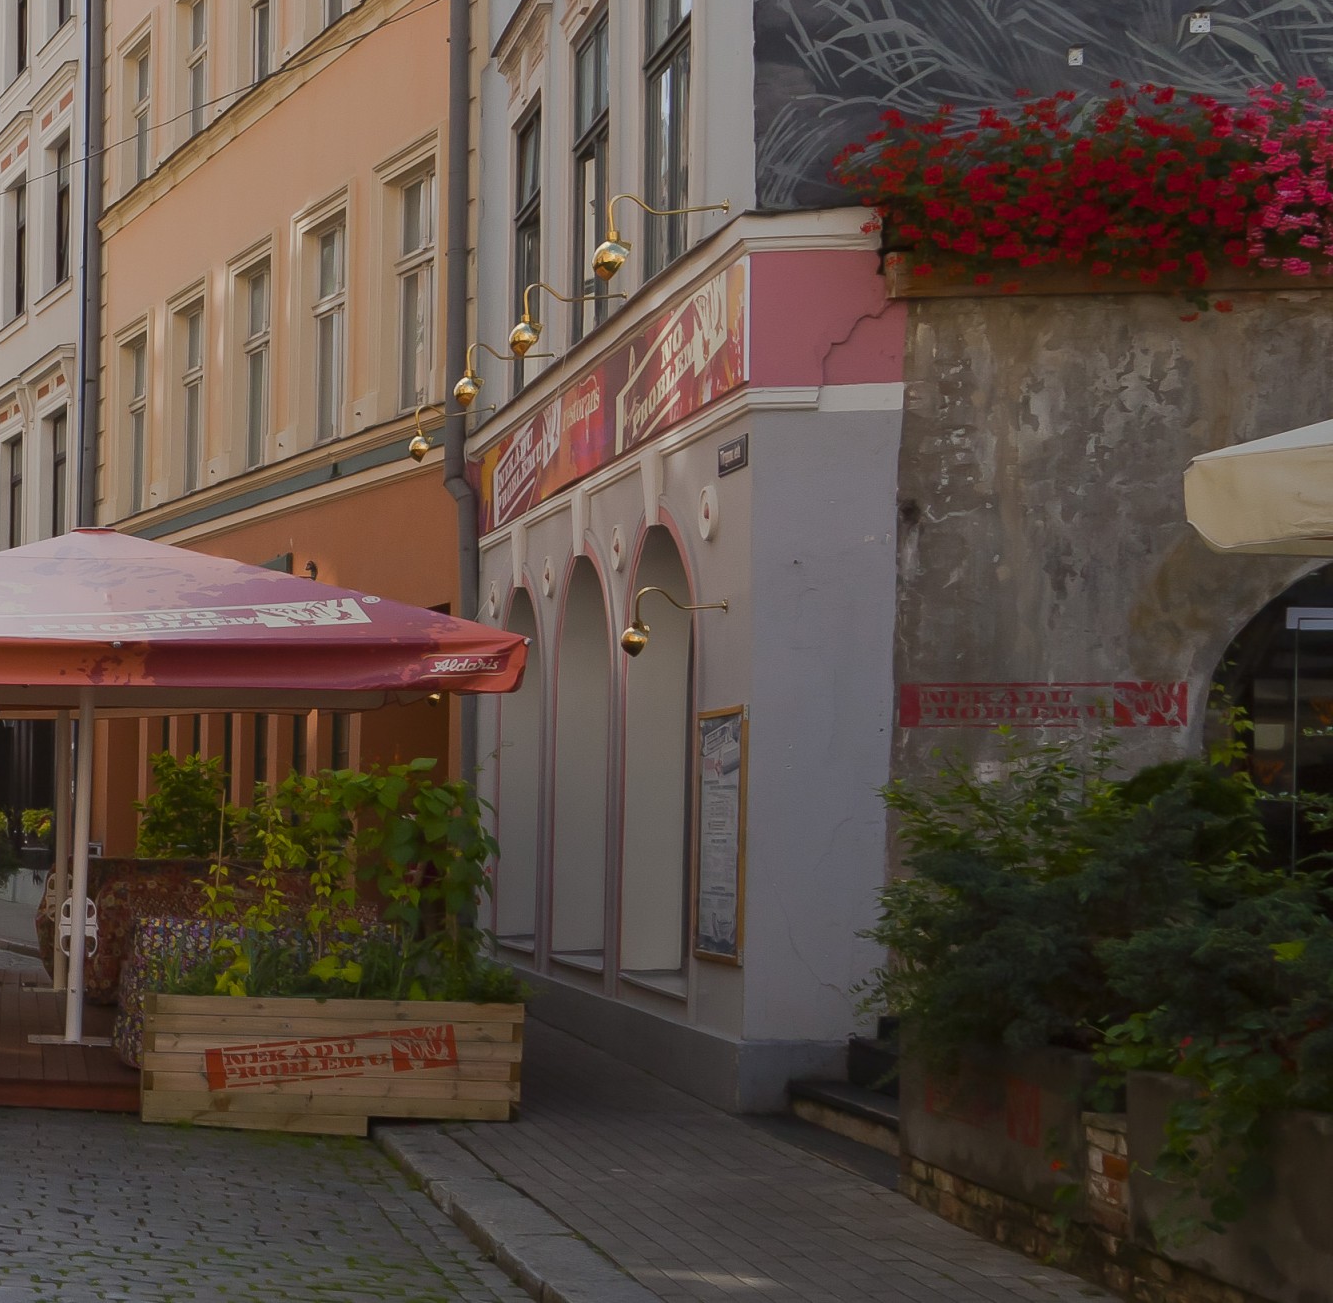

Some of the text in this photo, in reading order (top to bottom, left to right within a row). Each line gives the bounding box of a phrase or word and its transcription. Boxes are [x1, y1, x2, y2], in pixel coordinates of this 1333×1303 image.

[661, 321, 685, 370] NO
[632, 338, 696, 439] PROBLEM
[430, 659, 500, 673] Aldaris
